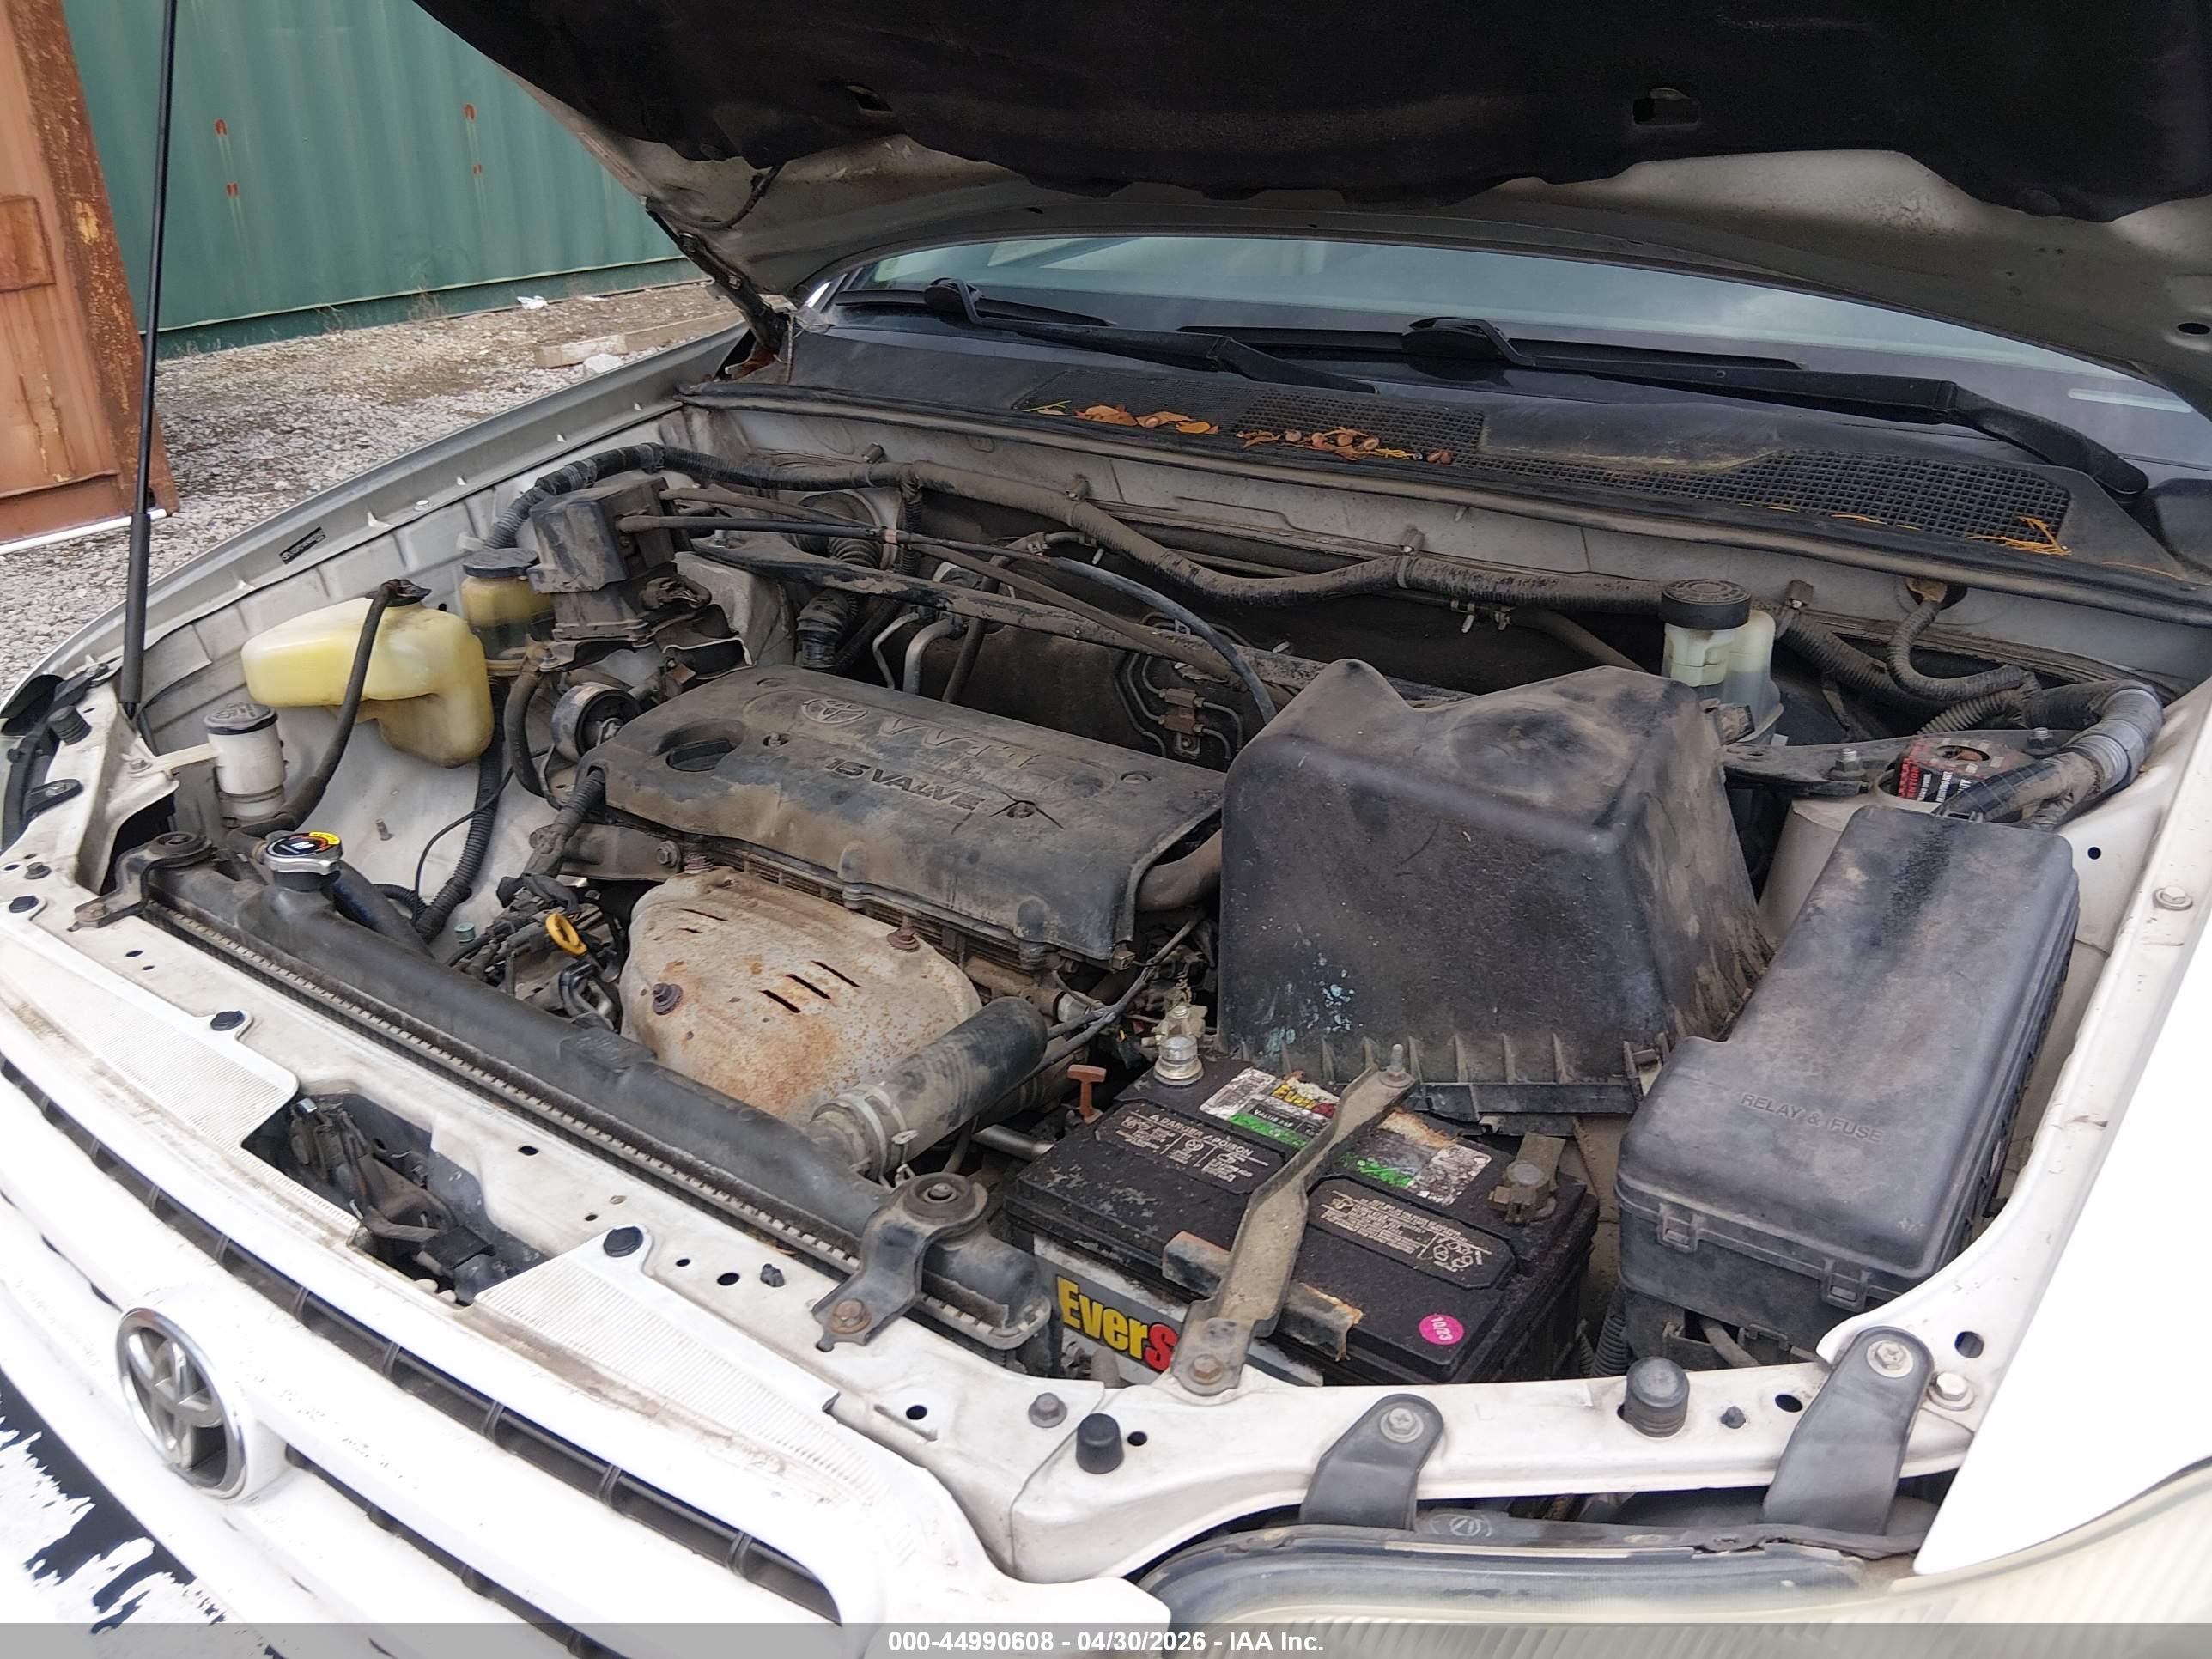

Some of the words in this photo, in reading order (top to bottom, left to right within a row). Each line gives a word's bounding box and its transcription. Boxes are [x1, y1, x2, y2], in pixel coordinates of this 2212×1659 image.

[872, 769, 985, 811] VALVE
[1160, 1117, 1203, 1138] DANGER
[1212, 1135, 1255, 1157] POISON
[1740, 1093, 1803, 1119] RELAY
[1807, 1111, 1822, 1127] &
[1830, 1117, 1884, 1143] FUSE
[1056, 1274, 1179, 1373] EverS
[1430, 1316, 1454, 1341] 10/23
